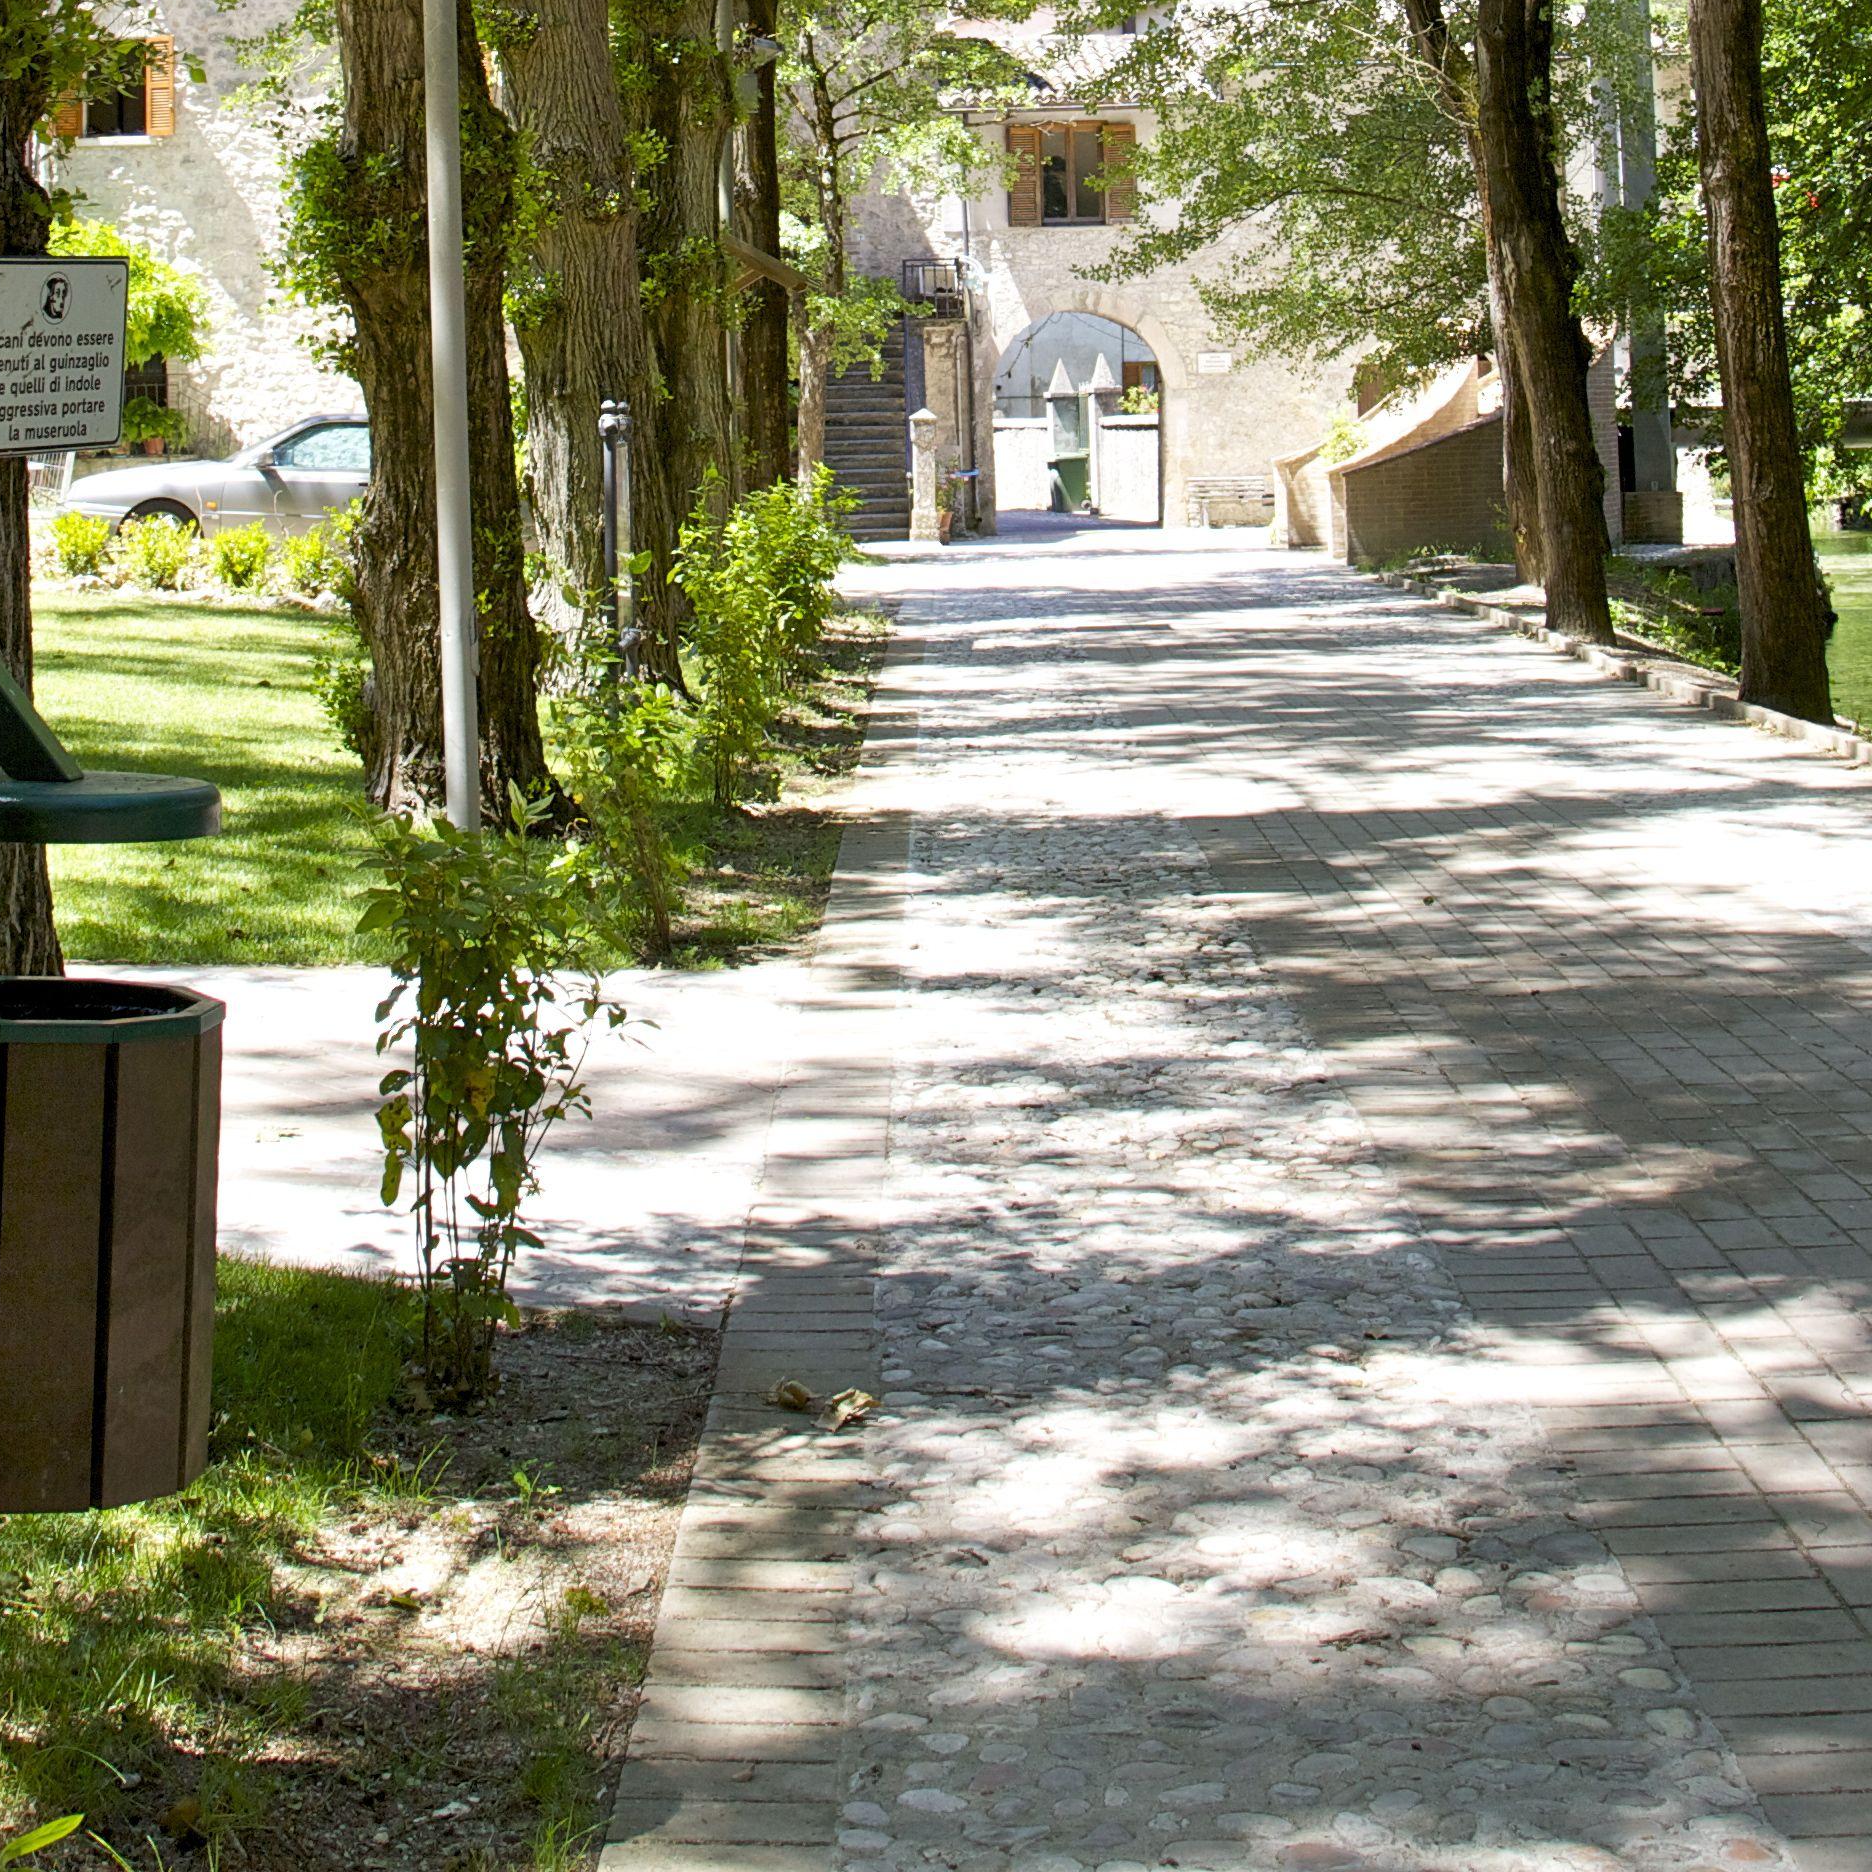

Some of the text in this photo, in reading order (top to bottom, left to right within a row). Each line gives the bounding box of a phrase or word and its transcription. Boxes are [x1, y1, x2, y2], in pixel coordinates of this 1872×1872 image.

[28, 332, 72, 348] devono
[77, 332, 114, 346] essere
[34, 353, 45, 370] al
[50, 353, 109, 373] guinzaglio
[10, 379, 45, 397] quelli
[50, 377, 60, 392] di
[65, 376, 101, 391] indole
[62, 400, 104, 417] portare
[9, 421, 87, 440] la museruola
